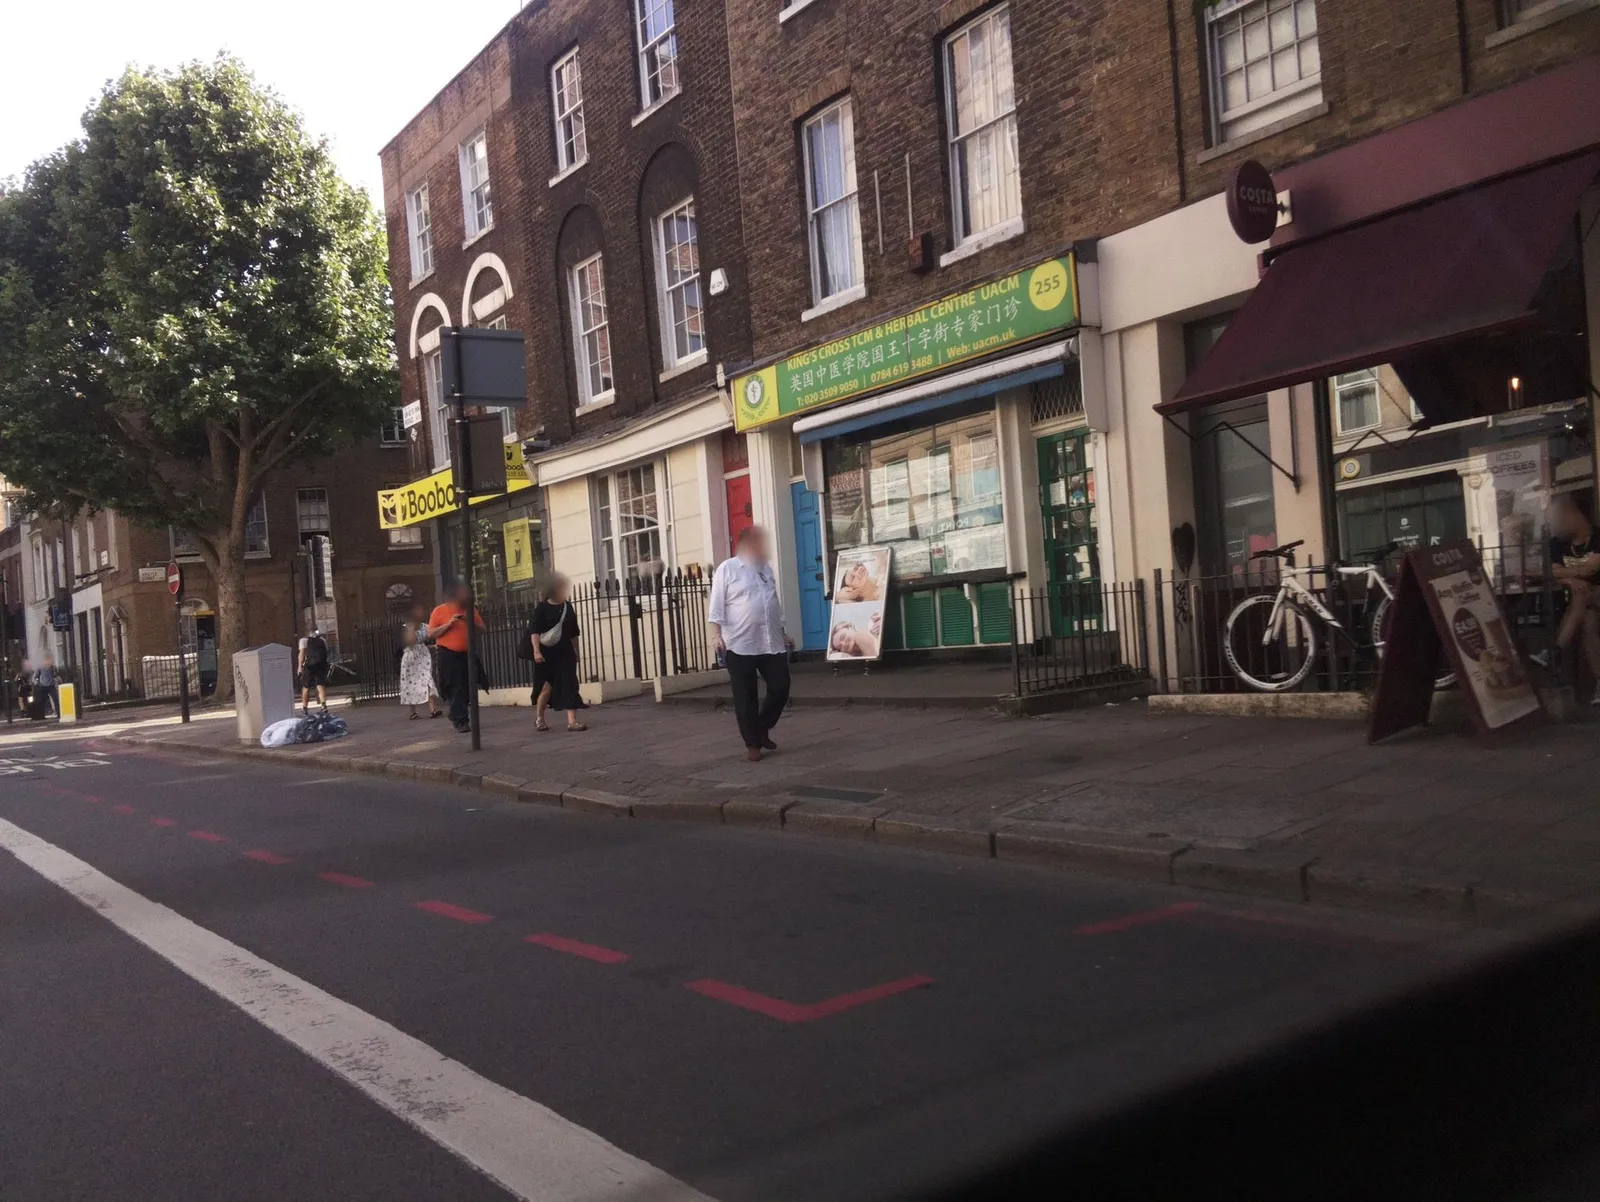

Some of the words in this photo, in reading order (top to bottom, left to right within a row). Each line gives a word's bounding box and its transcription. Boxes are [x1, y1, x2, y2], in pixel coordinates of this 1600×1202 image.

[1240, 185, 1274, 205] COSTA
[1034, 274, 1061, 296] 255
[787, 350, 818, 371] KING'S
[818, 338, 851, 360] CROSS
[849, 329, 874, 348] TCM
[875, 326, 884, 339] &
[885, 311, 929, 336] HERBAL
[930, 292, 976, 318] CENTRE
[980, 274, 1020, 301] UACM
[804, 392, 819, 405] 020
[819, 386, 838, 400] 3509
[839, 379, 859, 394] 9050
[870, 369, 892, 383] 0784
[892, 362, 909, 376] 619
[911, 355, 933, 370] 3488
[946, 341, 971, 359] Web:
[972, 327, 1016, 350] uacm.uk
[407, 481, 457, 518] Boobo
